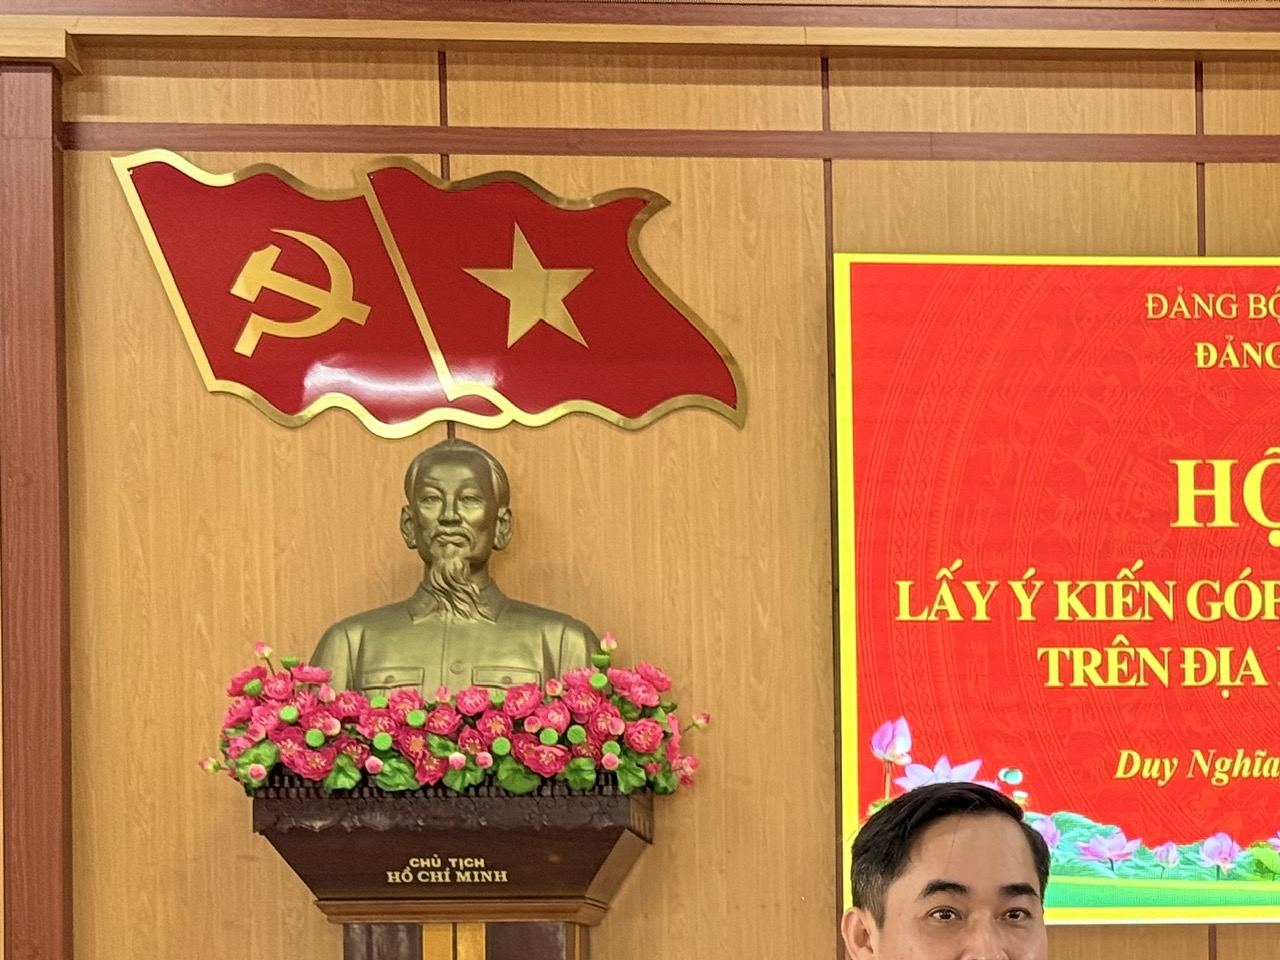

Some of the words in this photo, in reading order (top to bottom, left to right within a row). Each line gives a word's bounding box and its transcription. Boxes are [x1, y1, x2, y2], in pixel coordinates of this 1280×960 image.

[1147, 288, 1237, 318] ĐẢNG
[896, 559, 998, 620] LẤY
[1008, 568, 1043, 620] Ý
[1054, 560, 1176, 620] KIẾN
[1038, 635, 1171, 686] TRÊN
[1180, 647, 1268, 698] ĐỊA
[1115, 750, 1178, 786] Duy
[386, 866, 413, 883] HỒ
[417, 867, 452, 883] CHÍ
[456, 870, 508, 883] MINH
[409, 853, 441, 868] CHỦ
[448, 858, 485, 870] TỊCH
